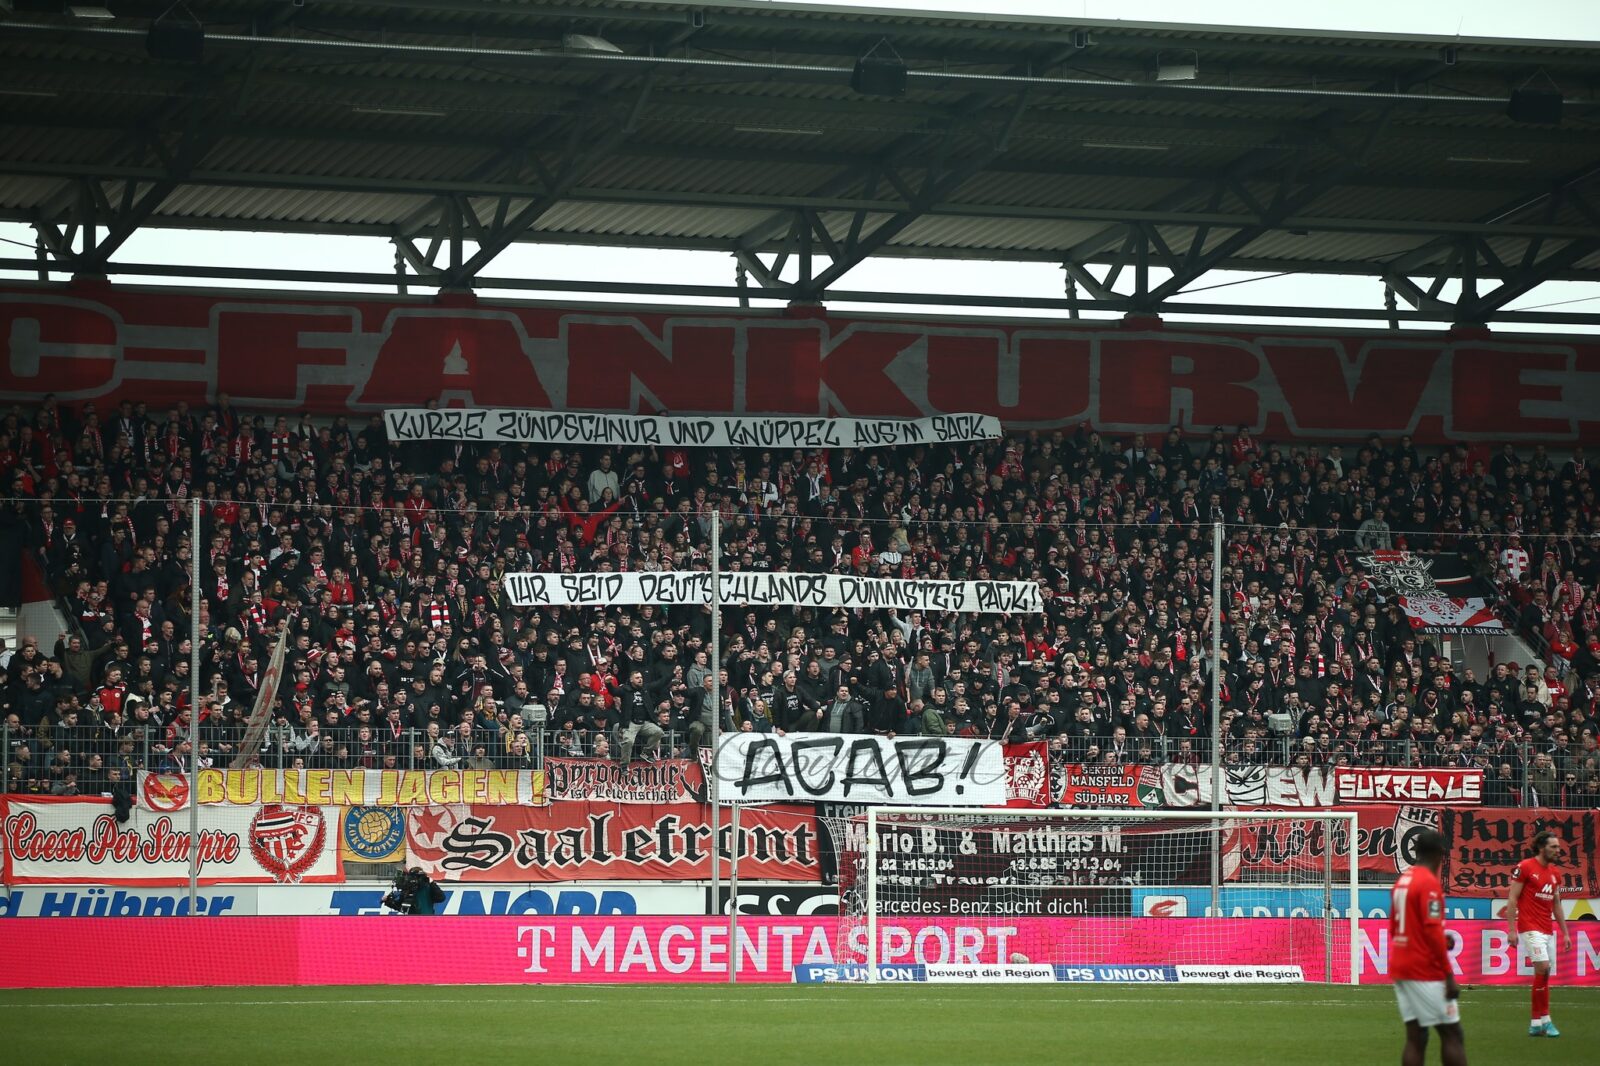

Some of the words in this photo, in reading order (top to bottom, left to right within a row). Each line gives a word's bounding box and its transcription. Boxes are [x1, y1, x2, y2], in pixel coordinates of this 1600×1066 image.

[390, 411, 487, 438] KURZE
[496, 412, 660, 444] ZÜNDSCHNUR
[669, 418, 714, 445] UND
[724, 419, 840, 446] KNÜPPEL
[510, 575, 550, 603] IHR
[561, 574, 622, 602] SEID
[639, 573, 827, 605] DEUTSCHLANDS
[839, 577, 965, 610] DÜMMSTES
[975, 582, 1037, 611] PACK!
[545, 761, 681, 797] Pyromanie
[734, 737, 982, 797] ACAB!
[1071, 775, 1134, 787] MANSFELD
[1082, 766, 1124, 775] SEKTION
[197, 768, 365, 805] BULLEN
[376, 769, 519, 806] JAGEN
[570, 787, 587, 799] ist
[594, 784, 679, 802] Leidenschaft
[1075, 792, 1128, 804] SÜDHARZ
[1339, 774, 1480, 799] SURREALE
[7, 811, 86, 862] Coesa
[87, 813, 141, 864] Per
[348, 823, 400, 854] LOKOMOTIVE
[441, 811, 819, 870] Saalefront
[845, 823, 913, 853] Mrio
[922, 825, 944, 853] B.
[959, 828, 977, 855] &
[992, 825, 1094, 854] Matthias
[40, 888, 235, 916] Hübner
[995, 897, 1043, 914] sucht
[1047, 897, 1088, 914] dich!
[1358, 928, 1464, 975] NR
[809, 968, 839, 980] PS
[844, 968, 913, 980] UNION
[929, 969, 978, 979] bewegt
[982, 969, 1001, 977] die
[1005, 969, 1049, 979] Region
[1068, 969, 1095, 980] PS
[1099, 969, 1164, 980] UNION
[1181, 970, 1229, 980] bewegt
[1234, 970, 1253, 978] die
[1257, 970, 1300, 980] Region
